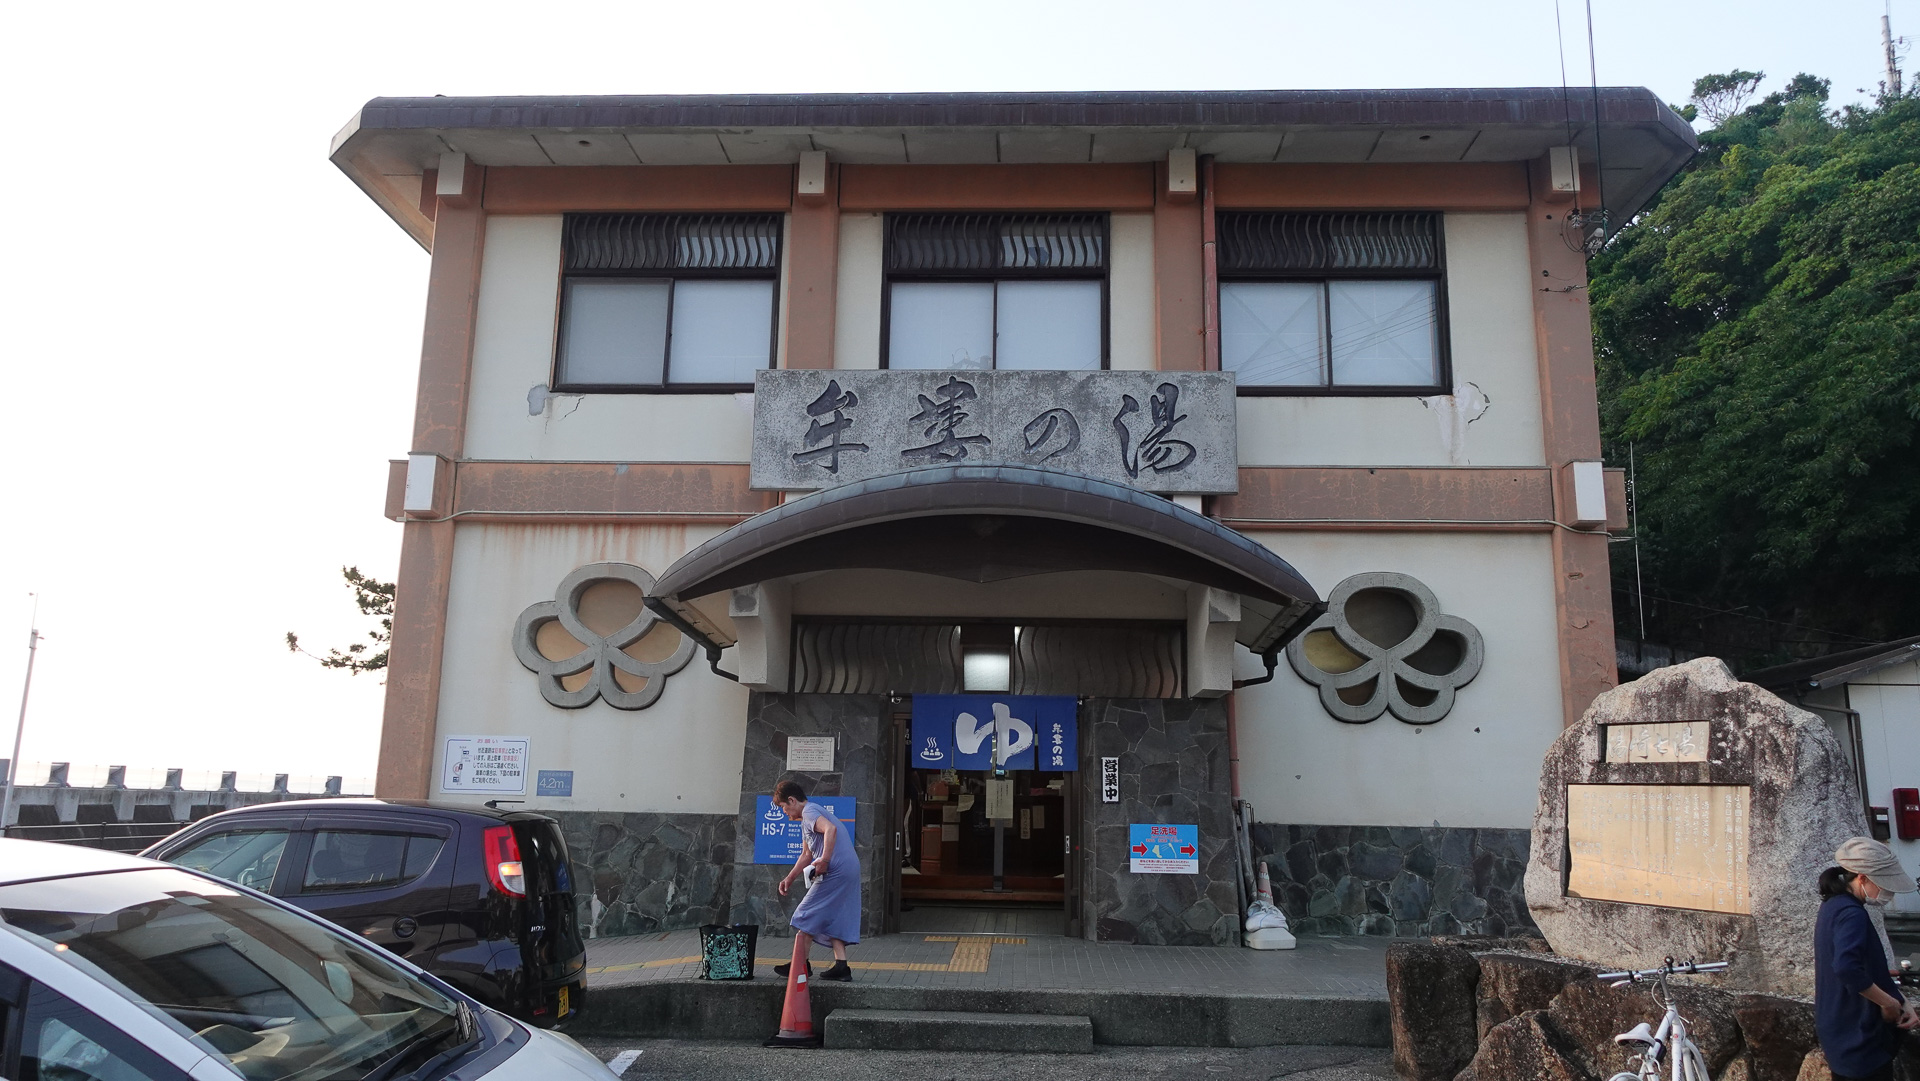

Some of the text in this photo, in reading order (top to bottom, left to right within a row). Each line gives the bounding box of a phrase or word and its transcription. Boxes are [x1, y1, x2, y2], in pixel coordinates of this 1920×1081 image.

[792, 377, 1196, 478] 牟婁の湯
[955, 702, 1033, 766] ゆ
[1051, 722, 1064, 766] 牟婁の湯
[1104, 759, 1118, 800] 営業中
[1151, 826, 1178, 835] 足洗場
